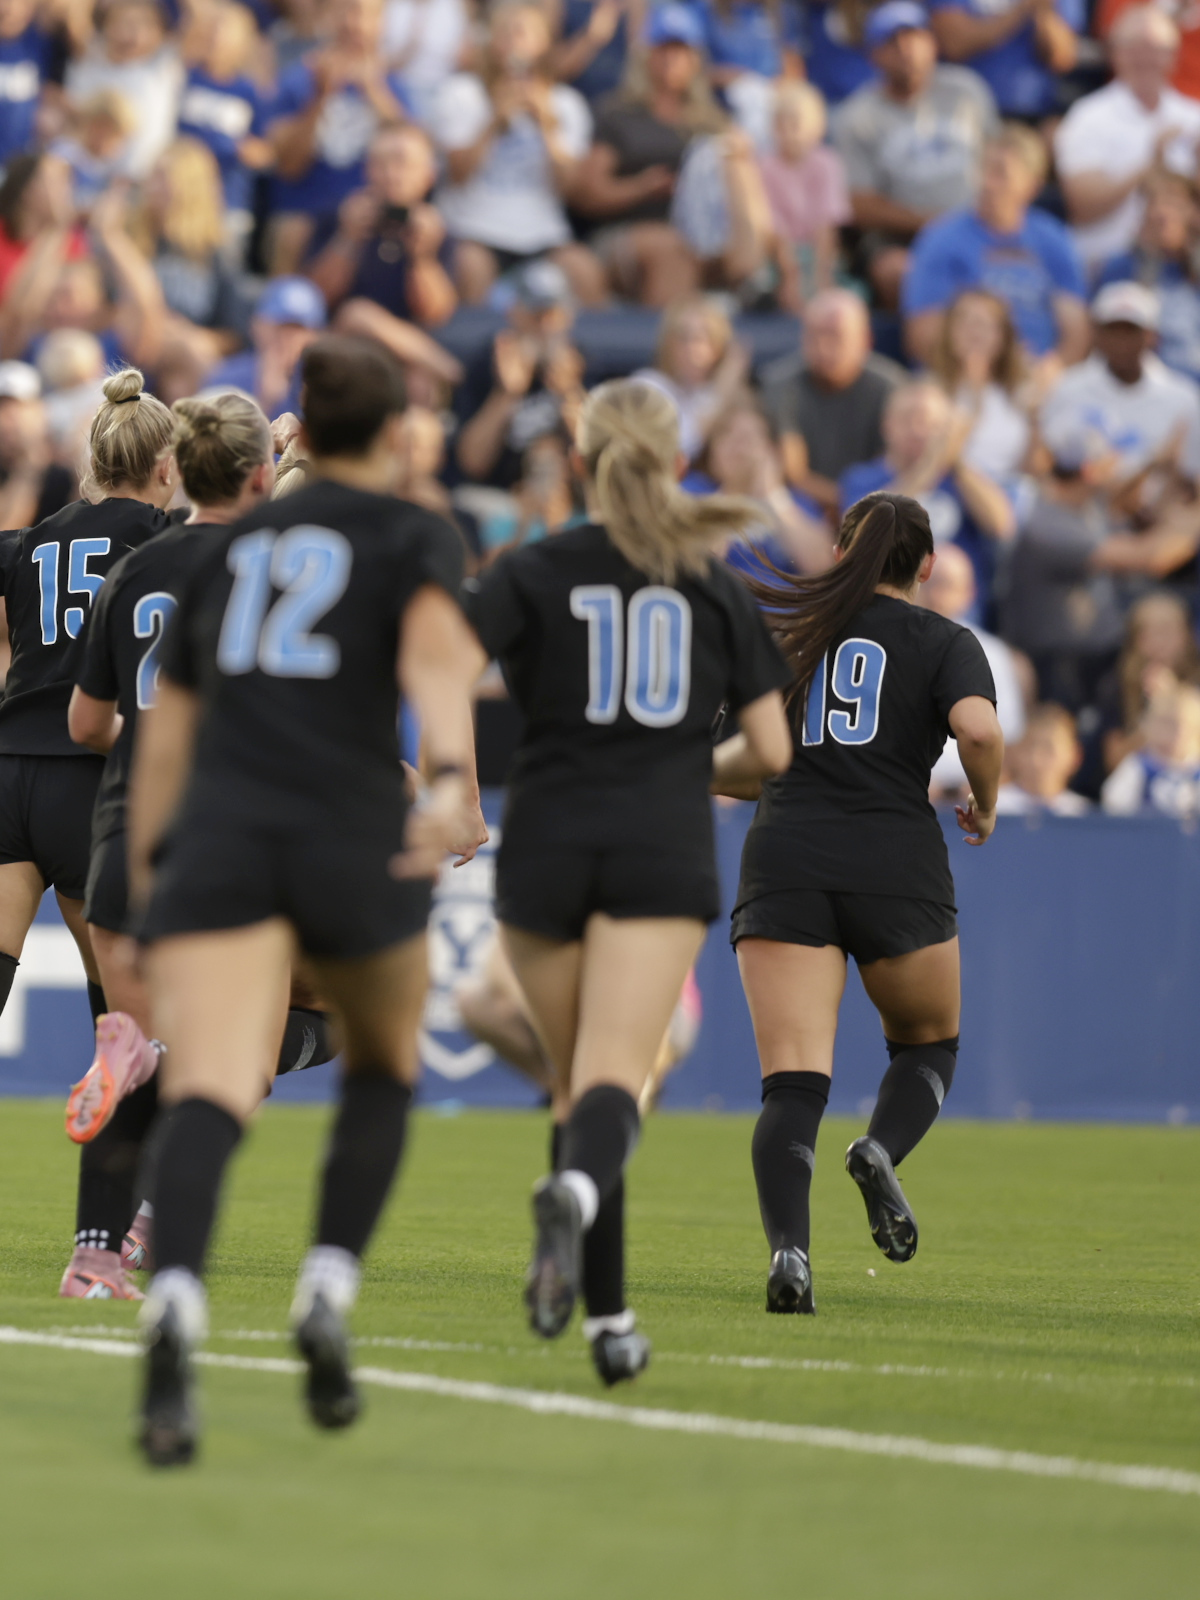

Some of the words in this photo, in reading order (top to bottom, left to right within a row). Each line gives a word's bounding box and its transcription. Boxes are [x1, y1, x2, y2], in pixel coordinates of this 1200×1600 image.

[32, 537, 111, 645] 15
[217, 524, 353, 680] 12
[570, 584, 693, 728] 10
[802, 638, 887, 746] 19
